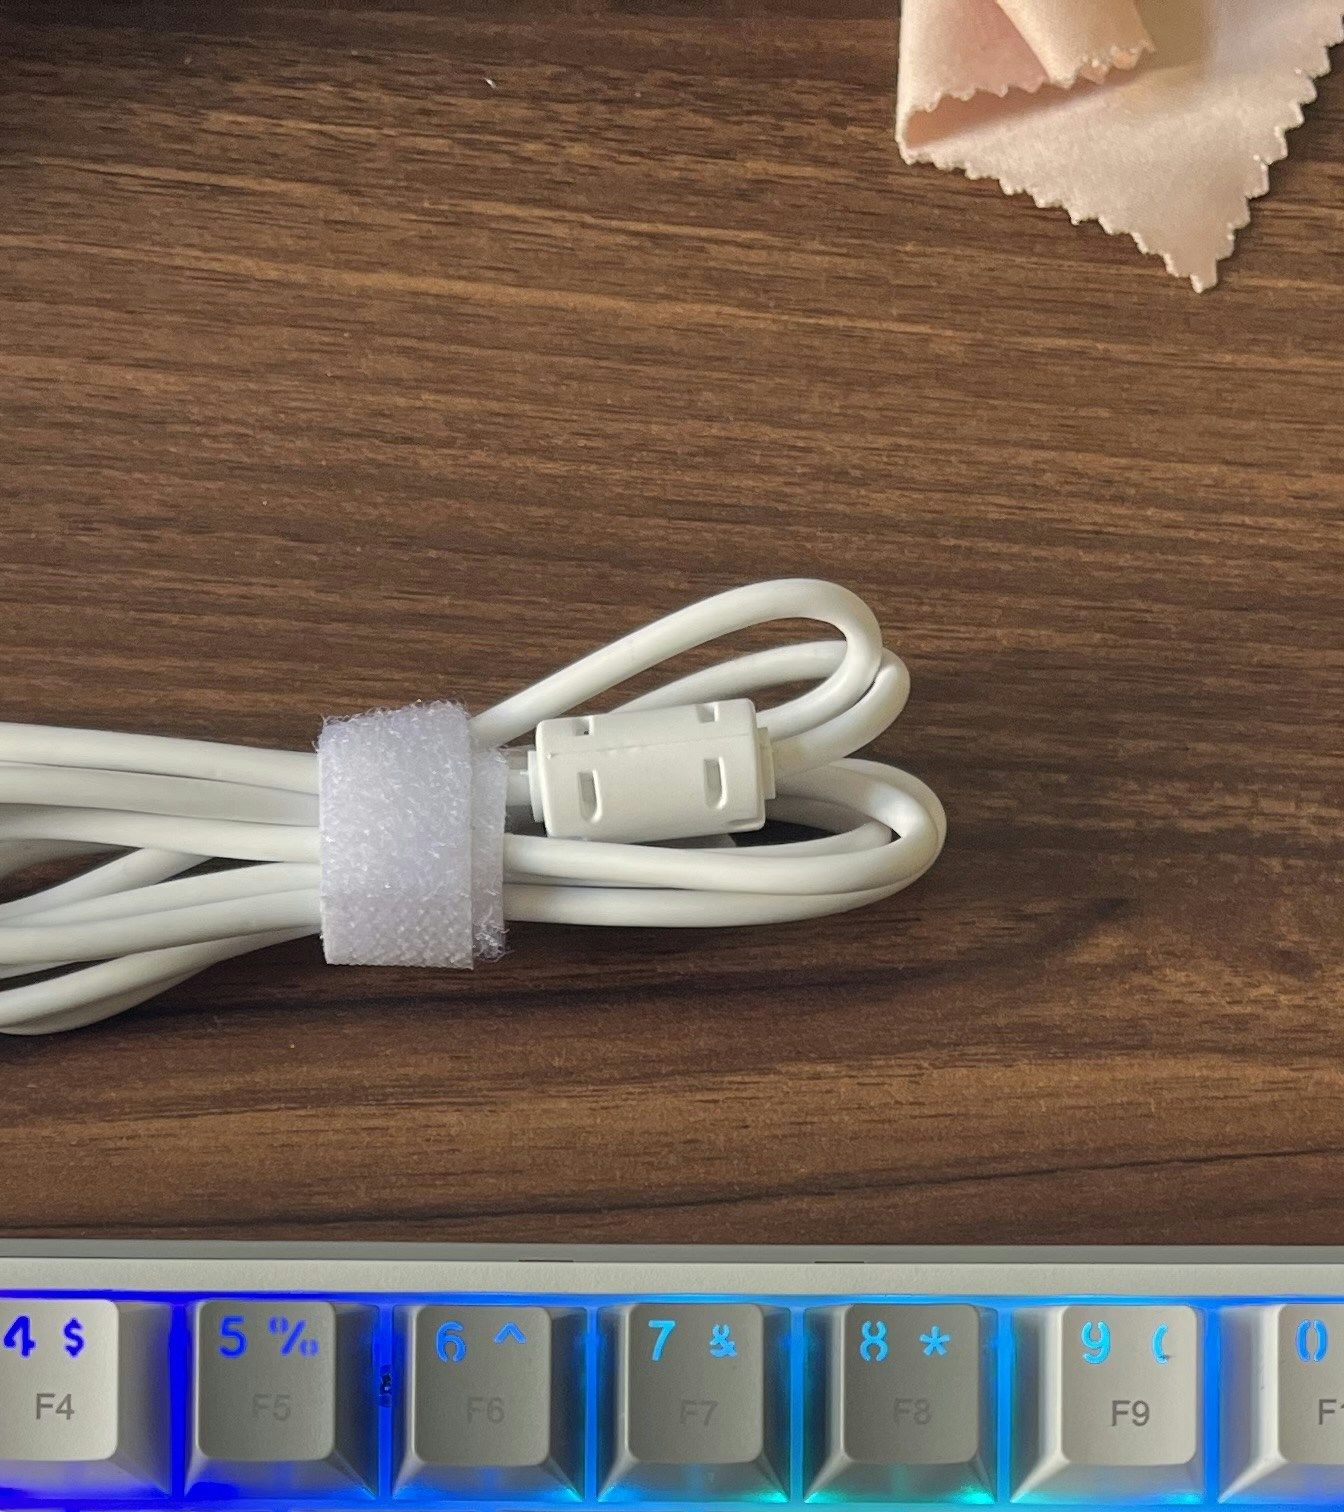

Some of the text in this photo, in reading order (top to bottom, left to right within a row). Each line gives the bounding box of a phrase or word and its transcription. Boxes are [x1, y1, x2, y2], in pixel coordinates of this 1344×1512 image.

[3, 1315, 35, 1358] 4
[219, 1316, 247, 1358] 5
[435, 1321, 466, 1362] 6
[647, 1320, 676, 1361] 7
[860, 1320, 888, 1362] 8
[1081, 1321, 1110, 1365] 9
[35, 1394, 75, 1421] F4
[252, 1394, 292, 1422] F5
[468, 1397, 505, 1424] F6
[680, 1400, 718, 1426] F7
[894, 1398, 933, 1425] F8
[1112, 1400, 1150, 1428] F9
